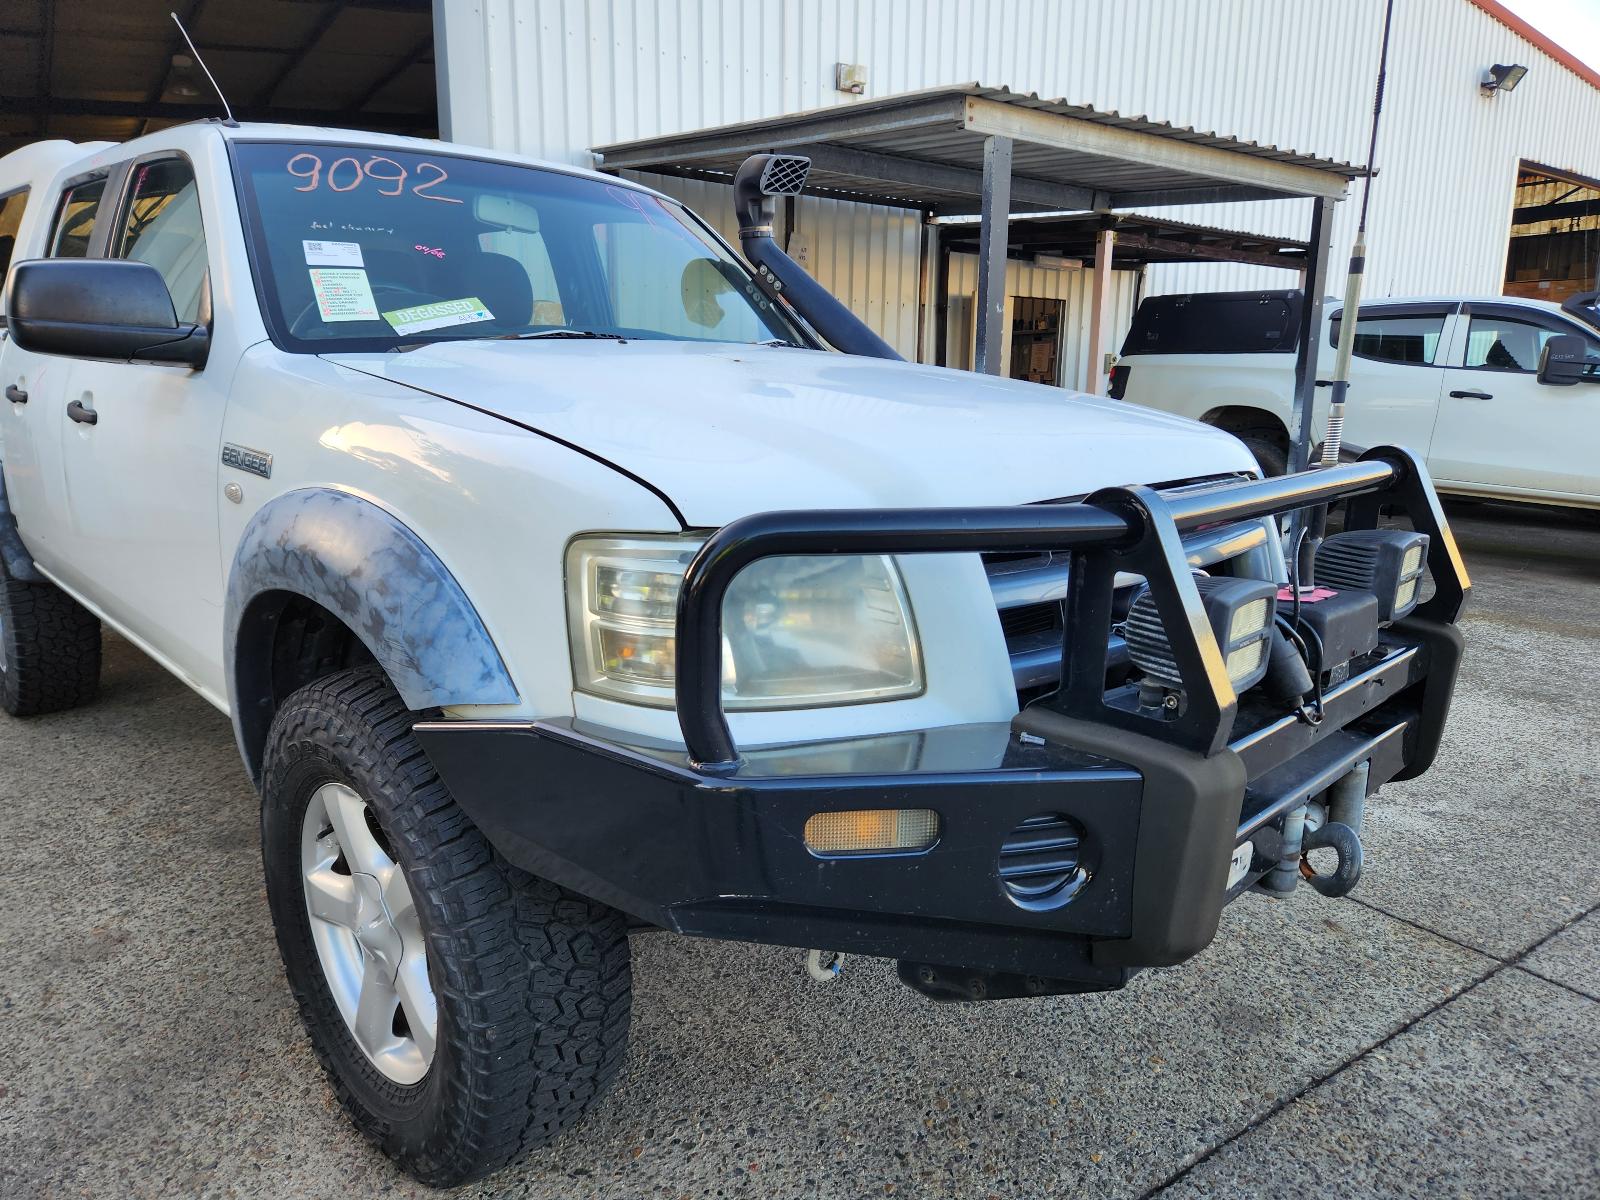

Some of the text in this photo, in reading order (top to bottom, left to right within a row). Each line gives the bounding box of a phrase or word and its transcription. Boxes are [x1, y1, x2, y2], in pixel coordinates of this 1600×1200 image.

[287, 153, 464, 204] 9092
[395, 301, 475, 323] DEGASSED
[222, 445, 270, 476] RANGER
